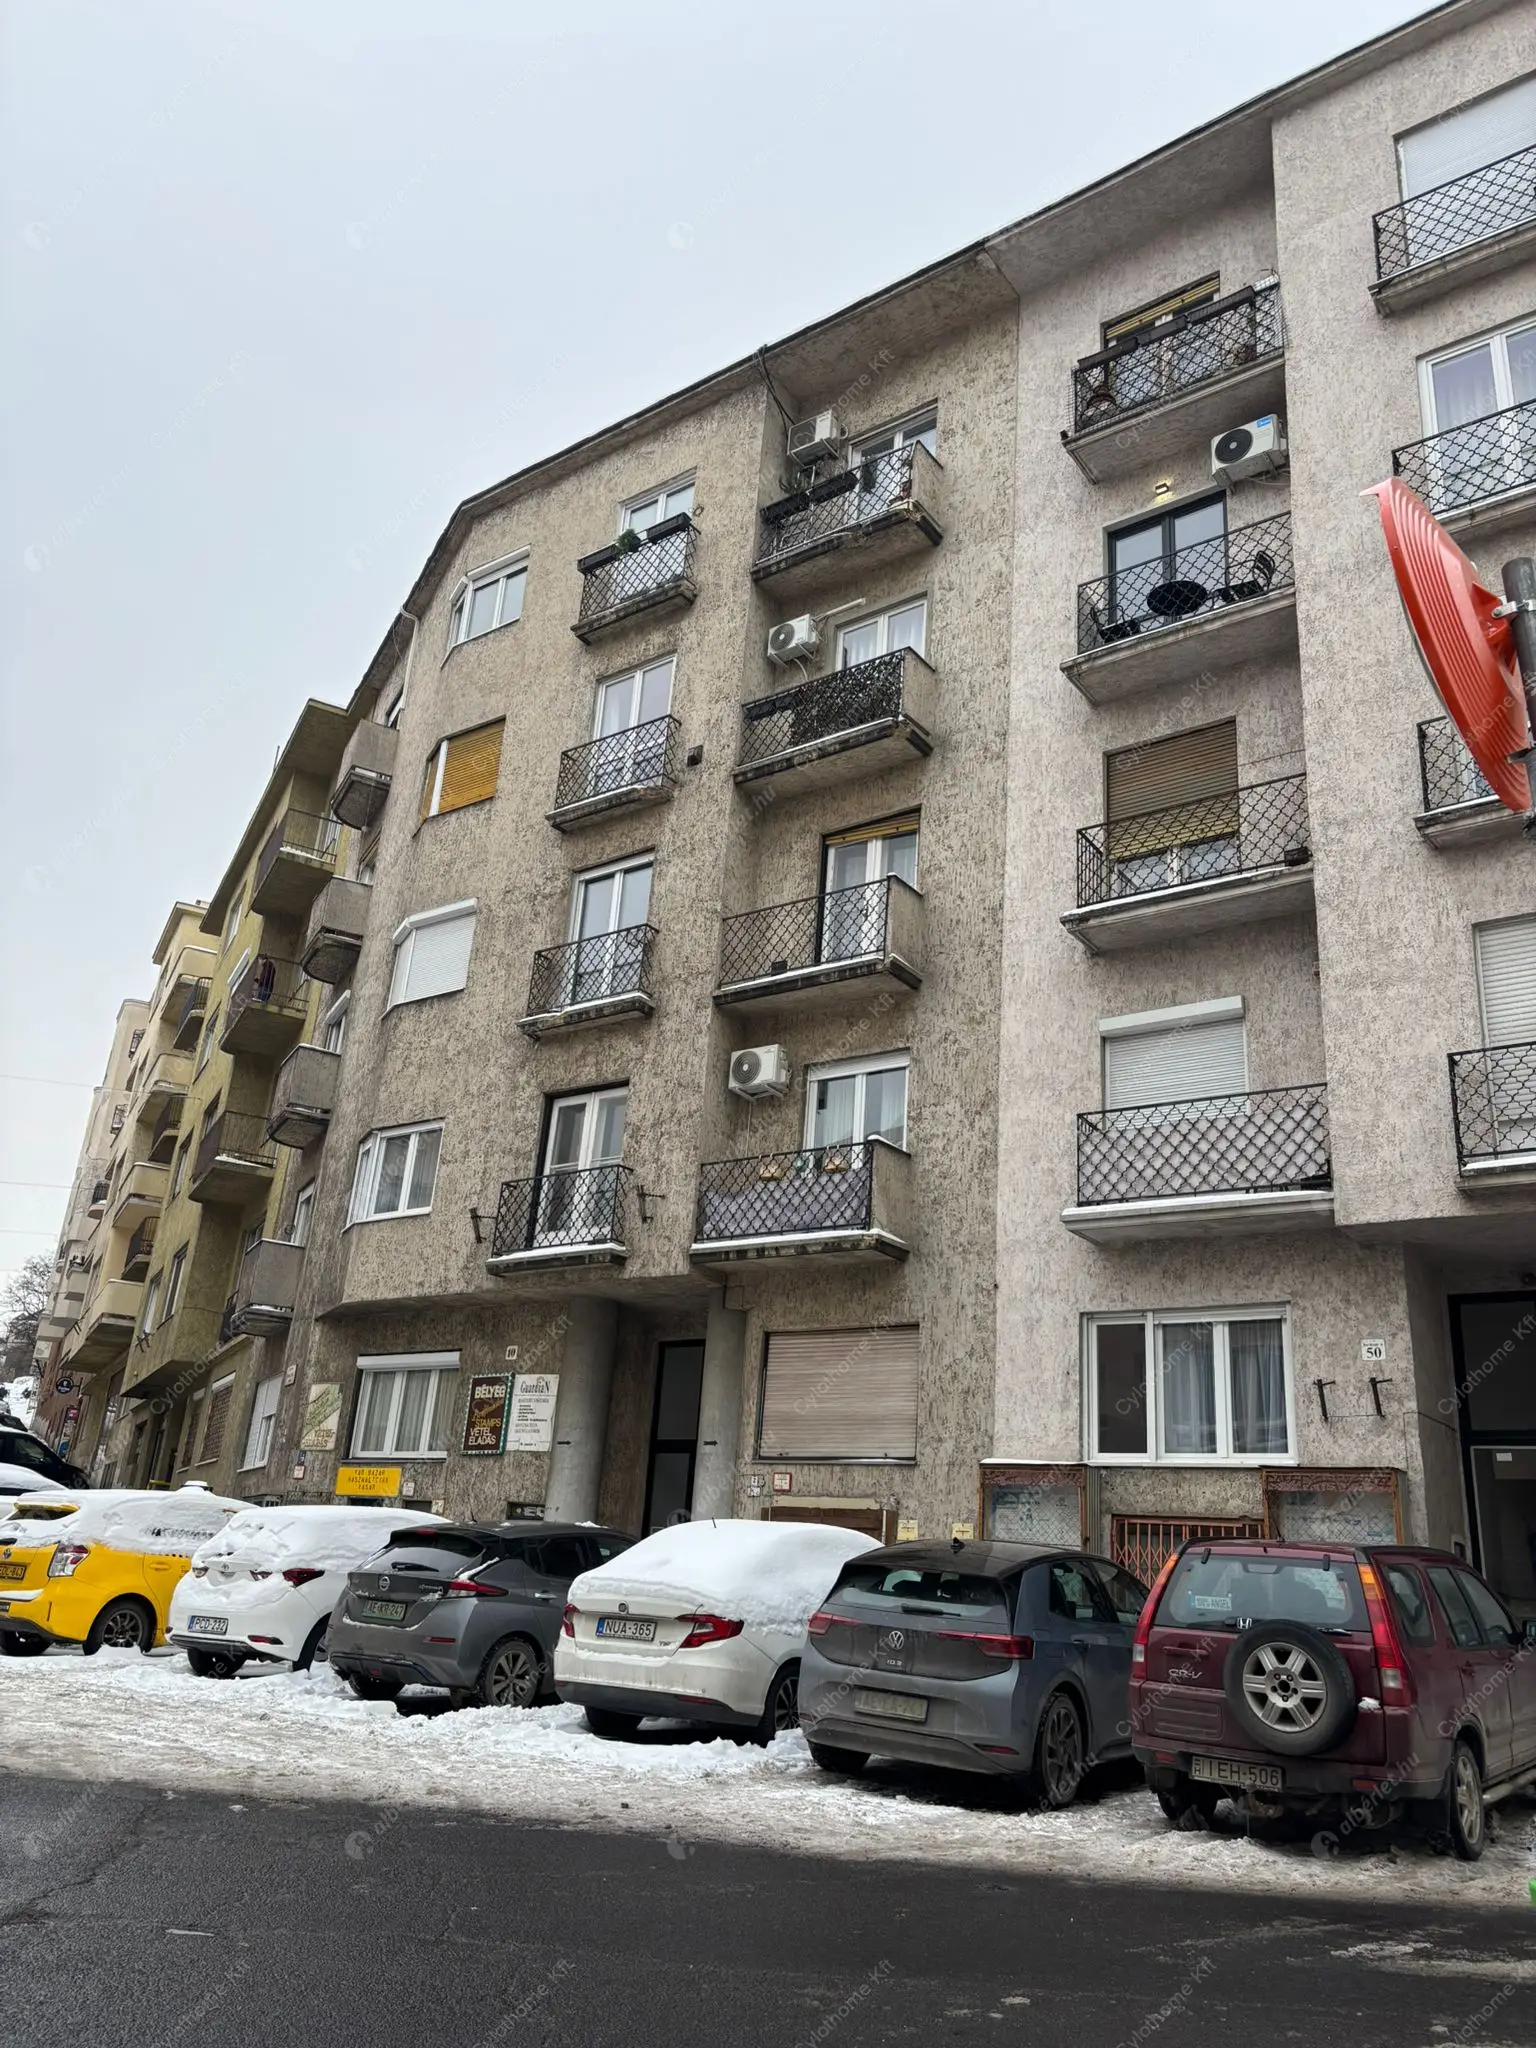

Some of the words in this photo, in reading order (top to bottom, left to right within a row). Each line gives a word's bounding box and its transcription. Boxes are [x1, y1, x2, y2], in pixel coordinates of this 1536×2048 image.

[1366, 1347, 1382, 1358] 50
[474, 1383, 507, 1399] BÉLYEG
[195, 1618, 226, 1631] PCD-232
[605, 1620, 652, 1637] NUA-365
[1168, 1668, 1202, 1679] CR-V
[1209, 1760, 1279, 1786] IEH-506
